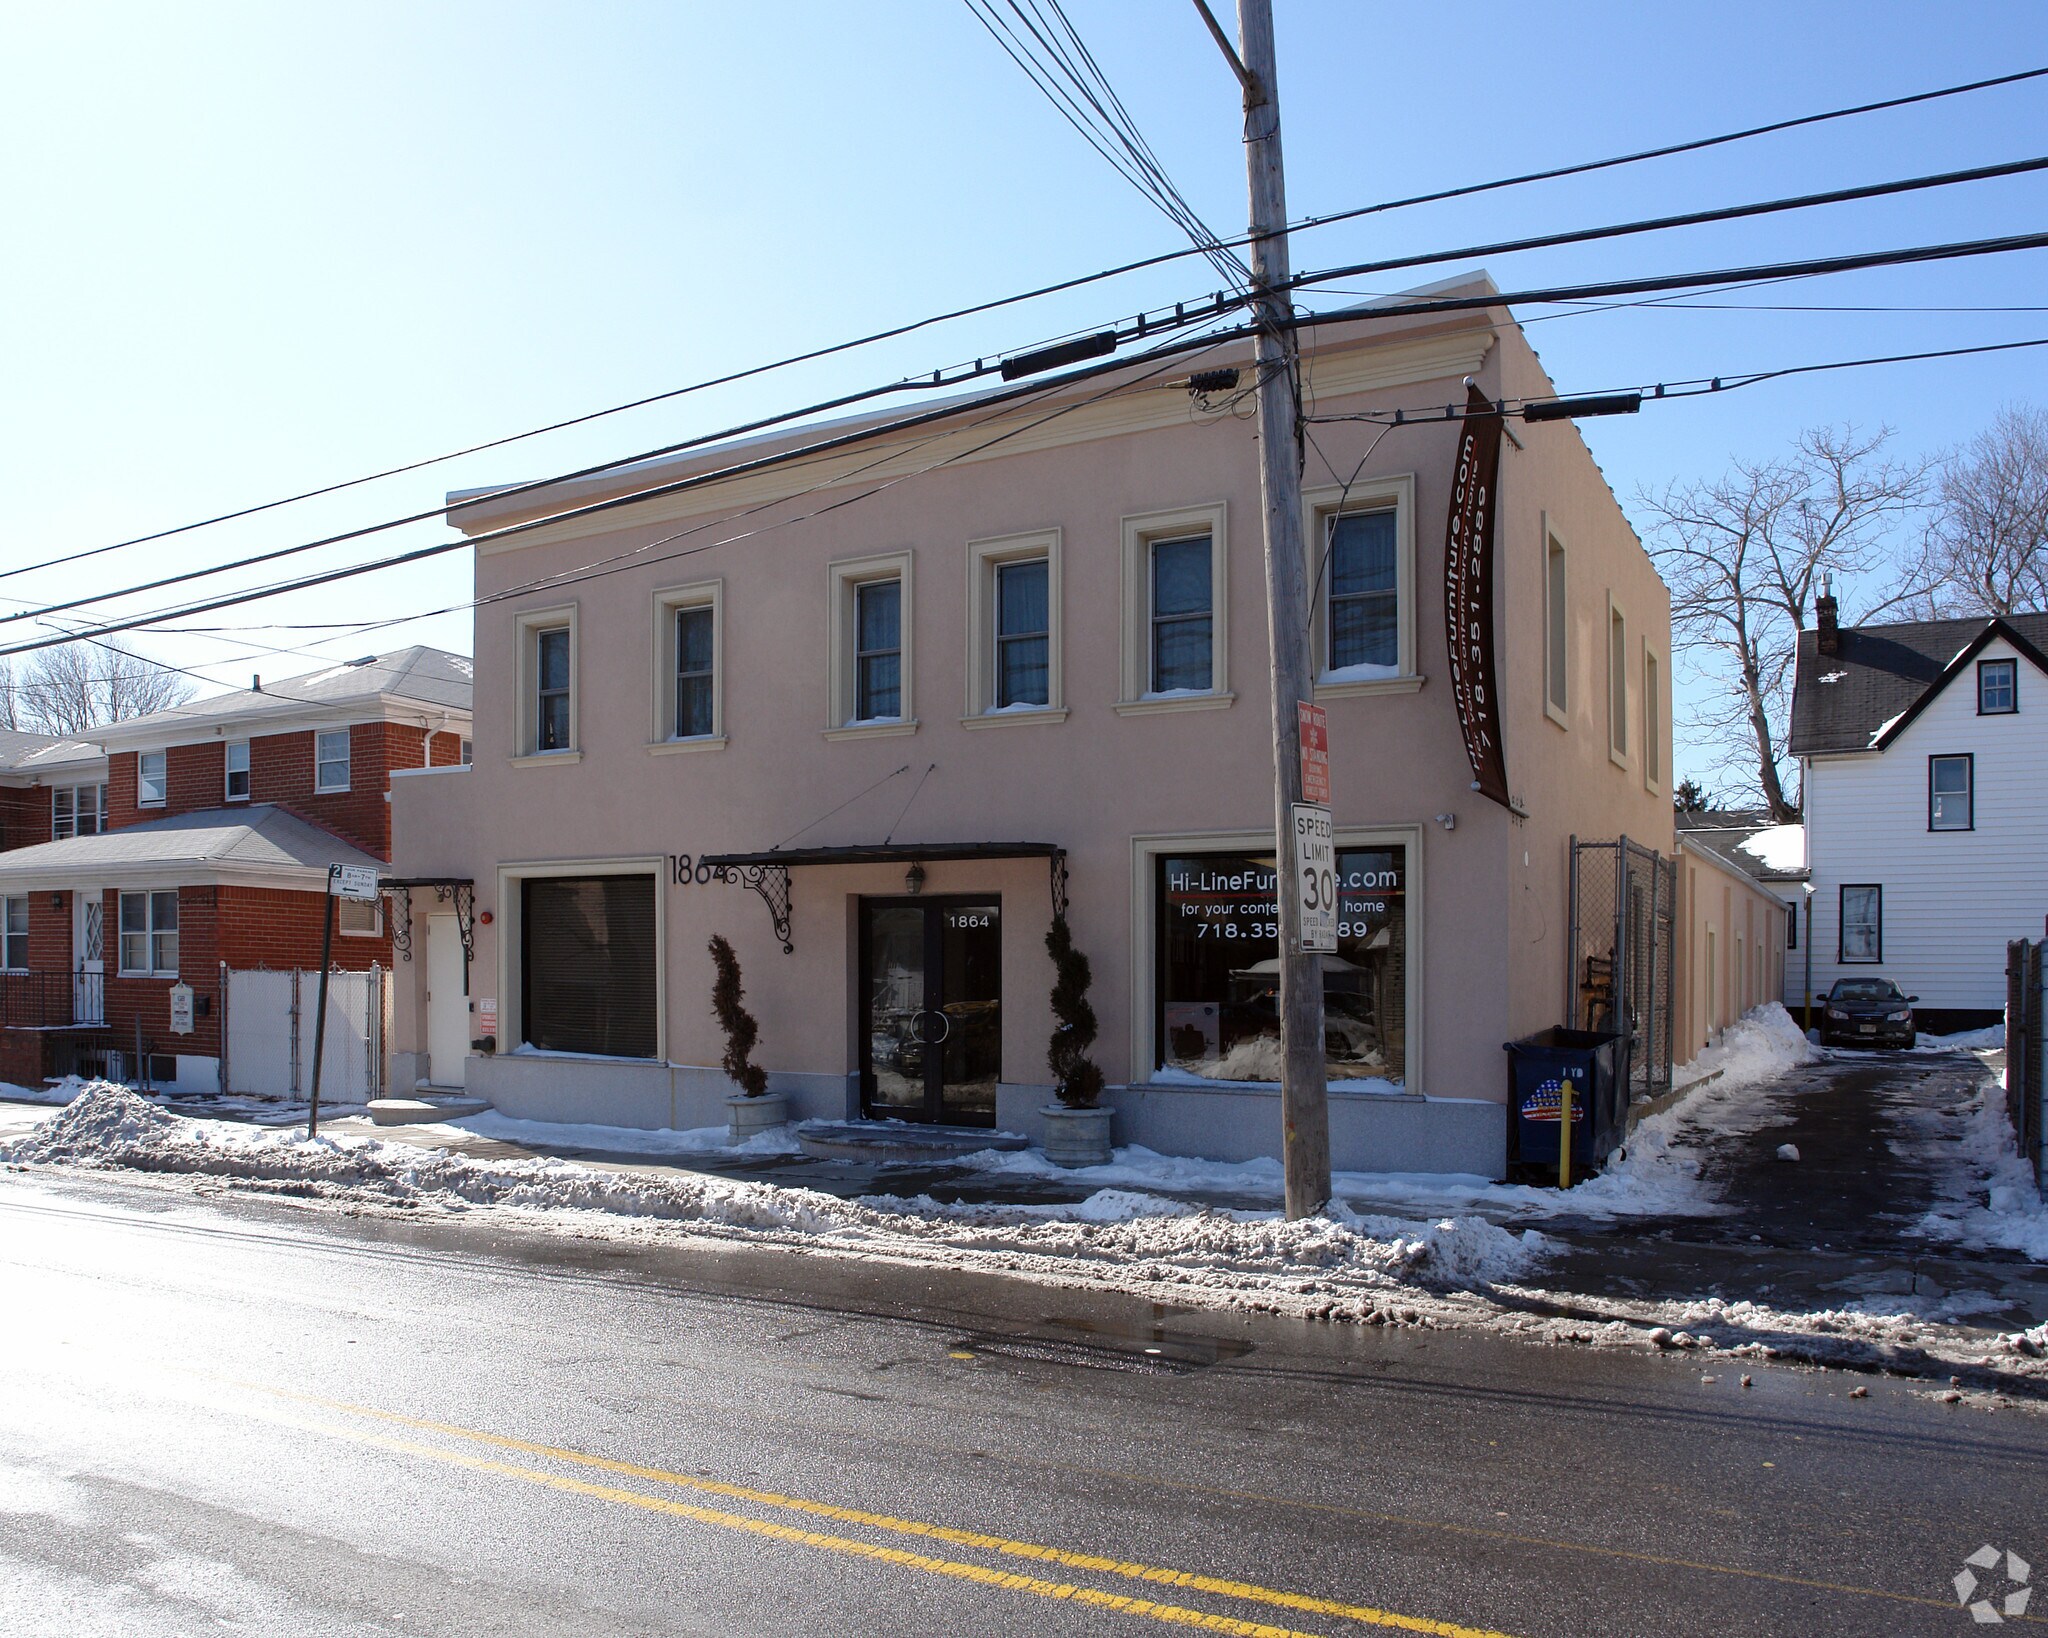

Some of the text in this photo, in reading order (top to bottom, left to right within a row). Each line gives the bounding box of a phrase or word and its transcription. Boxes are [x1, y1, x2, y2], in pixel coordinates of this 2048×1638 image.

[1466, 460, 1478, 517] home
[1460, 527, 1470, 671] contemporary
[1471, 485, 1491, 748] 718.351.2889
[1465, 679, 1475, 722] your
[1300, 708, 1311, 724] SNOW
[1297, 817, 1332, 839] SPEED
[1303, 842, 1330, 863] LIMIT
[333, 864, 341, 877] 2
[669, 854, 726, 884] 1864
[1303, 867, 1333, 912] 30
[1181, 902, 1200, 917] for
[1205, 903, 1235, 917] your
[1344, 900, 1386, 913] home
[949, 915, 989, 928] 1864
[1303, 916, 1319, 927] SPEED
